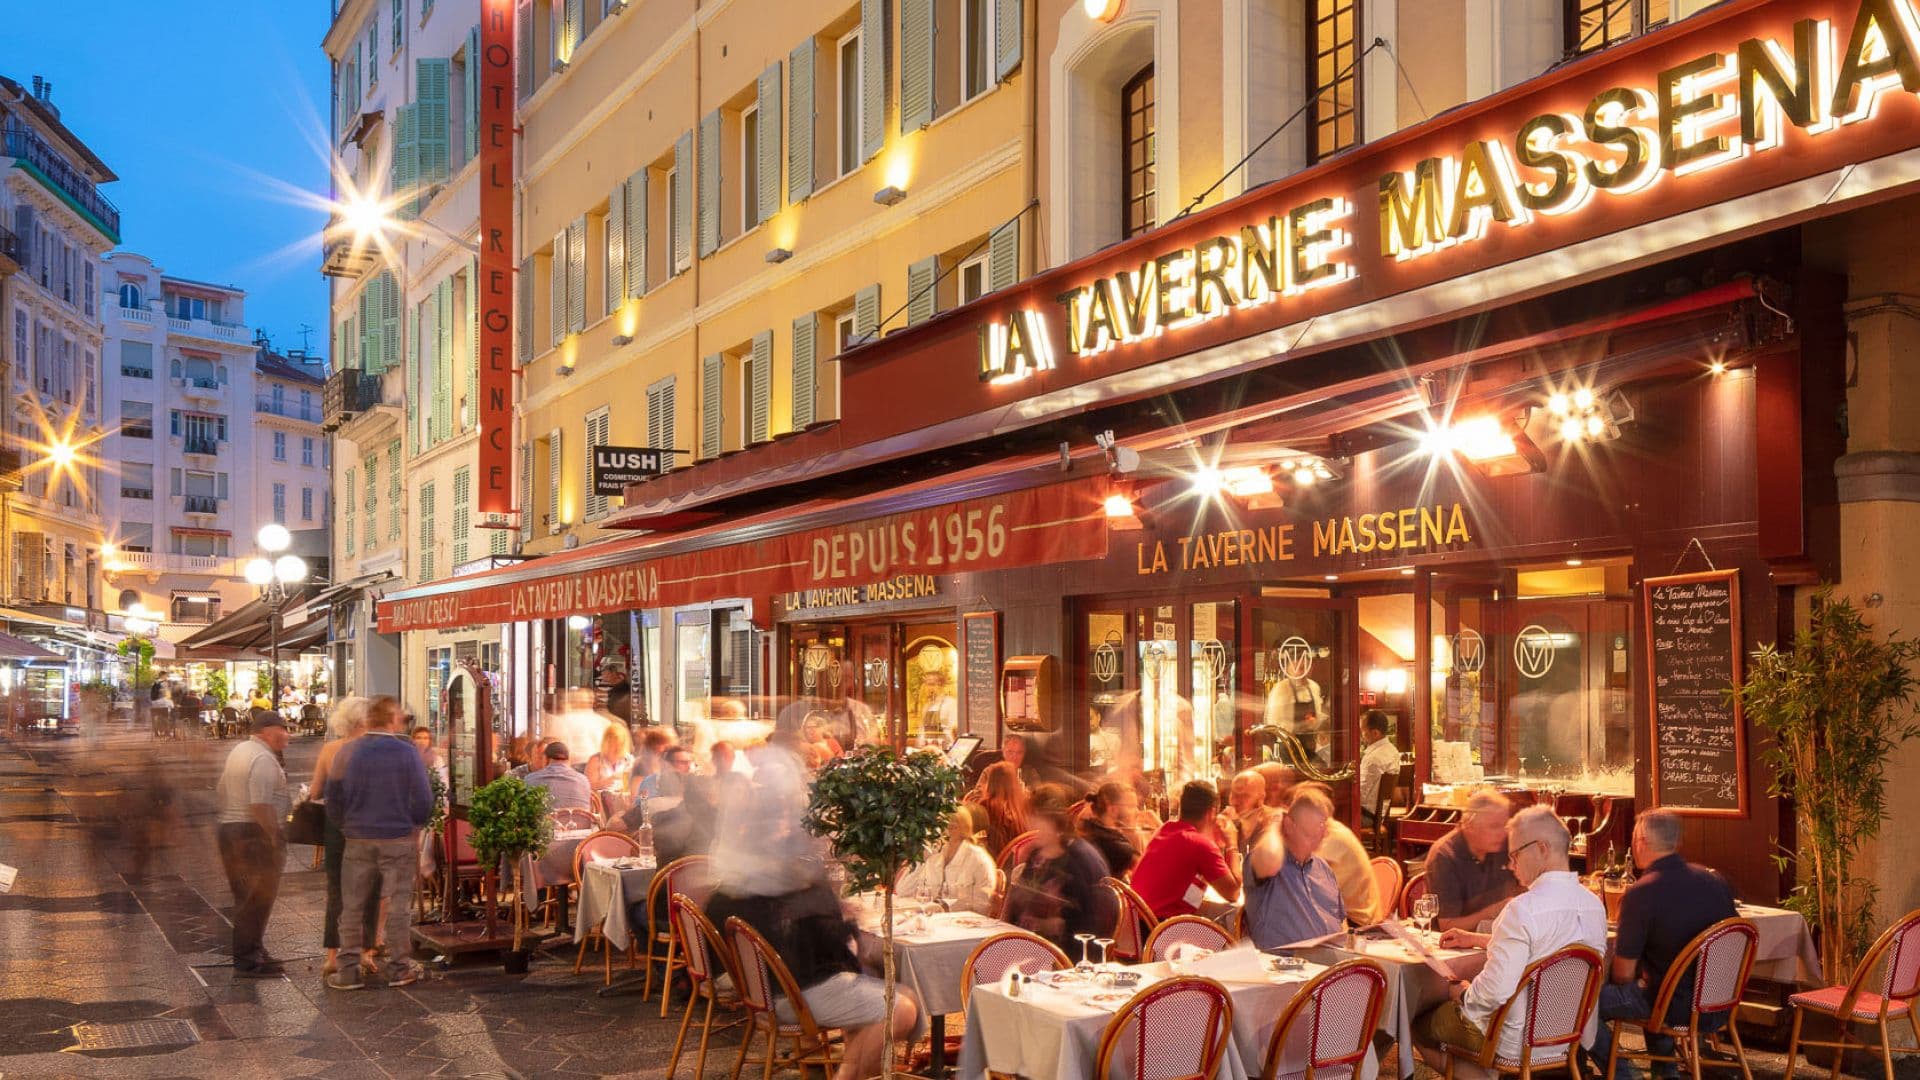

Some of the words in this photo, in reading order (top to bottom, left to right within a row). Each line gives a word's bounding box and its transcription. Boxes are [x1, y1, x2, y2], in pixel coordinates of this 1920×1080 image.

[486, 8, 510, 188] HOTEL
[978, 309, 1052, 384] LA
[1057, 197, 1353, 357] TAVERNE
[1380, 0, 1920, 262] MASSENA
[484, 229, 509, 490] REGENCE
[598, 452, 657, 470] LUSH
[812, 520, 916, 580] DEPUIS
[927, 504, 1006, 564] 1956
[1137, 542, 1168, 575] LA
[1178, 524, 1295, 570] TAVERNE
[1313, 503, 1471, 558] MASSENA
[511, 585, 527, 616] LA
[527, 575, 582, 613] TAVERNE
[785, 591, 800, 611] LA
[806, 584, 859, 608] TAVERNE
[866, 575, 937, 601] MASSENA
